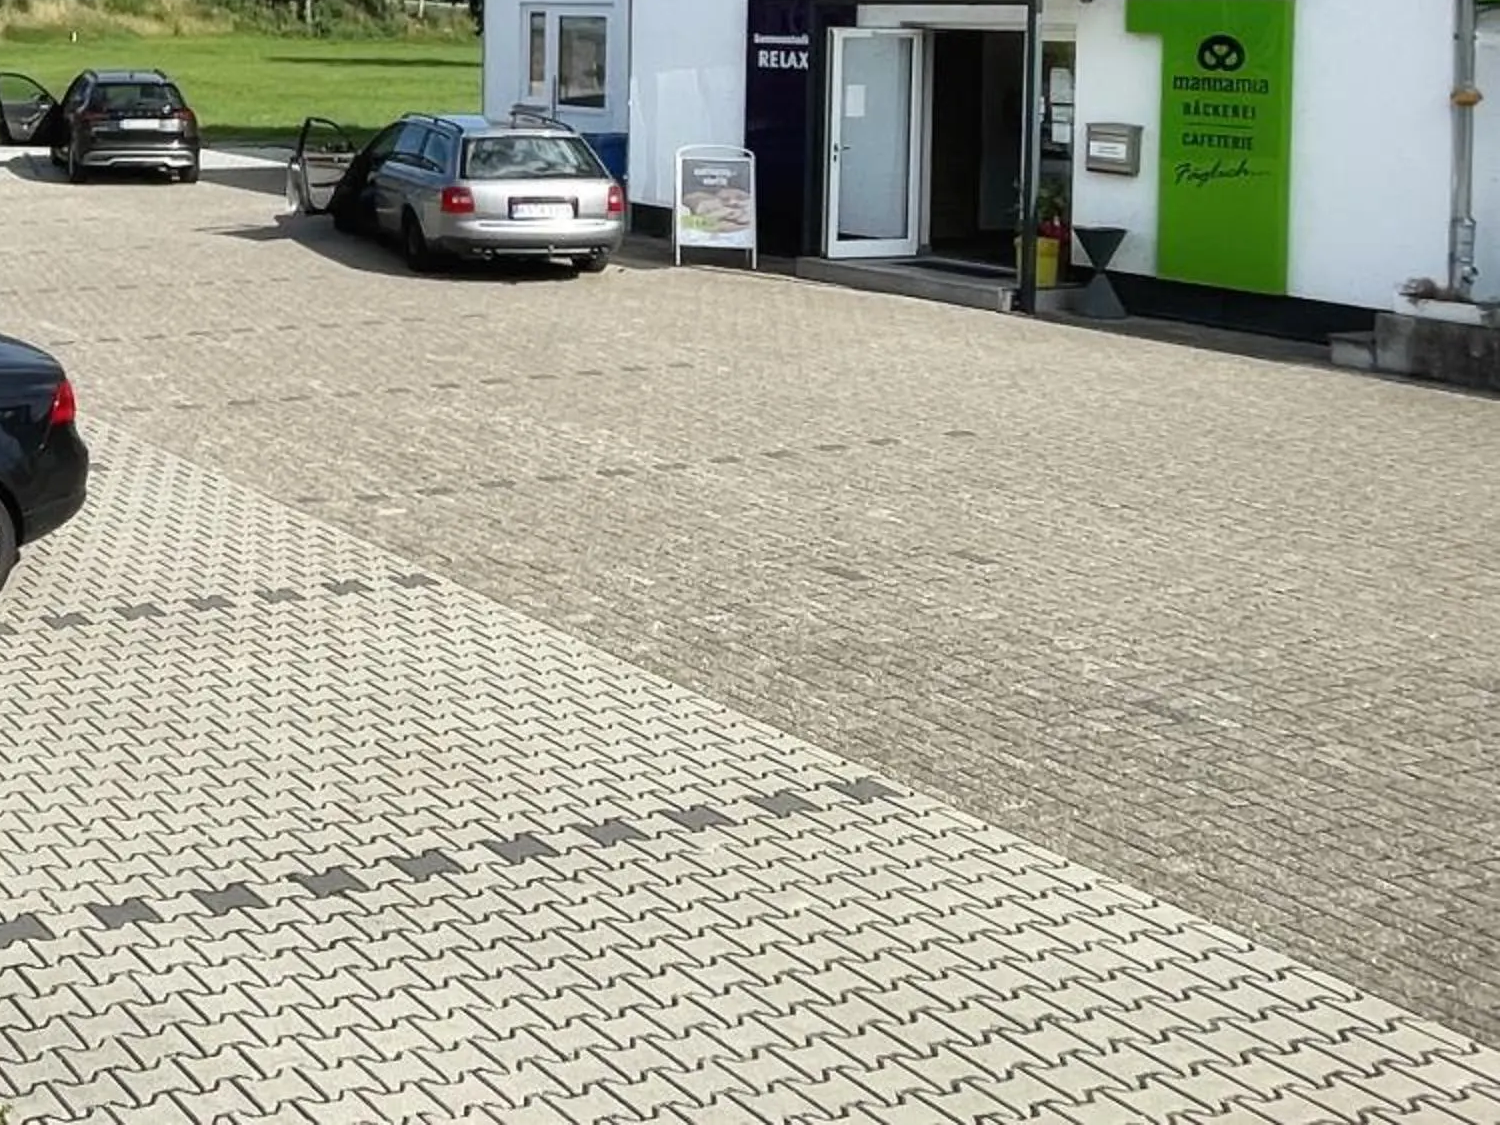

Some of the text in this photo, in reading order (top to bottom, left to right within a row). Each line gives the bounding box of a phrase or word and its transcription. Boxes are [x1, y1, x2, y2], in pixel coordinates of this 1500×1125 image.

[758, 49, 809, 70] RELAX
[1182, 100, 1256, 120] BÄCKEREI
[1181, 132, 1254, 151] CAFETERIE
